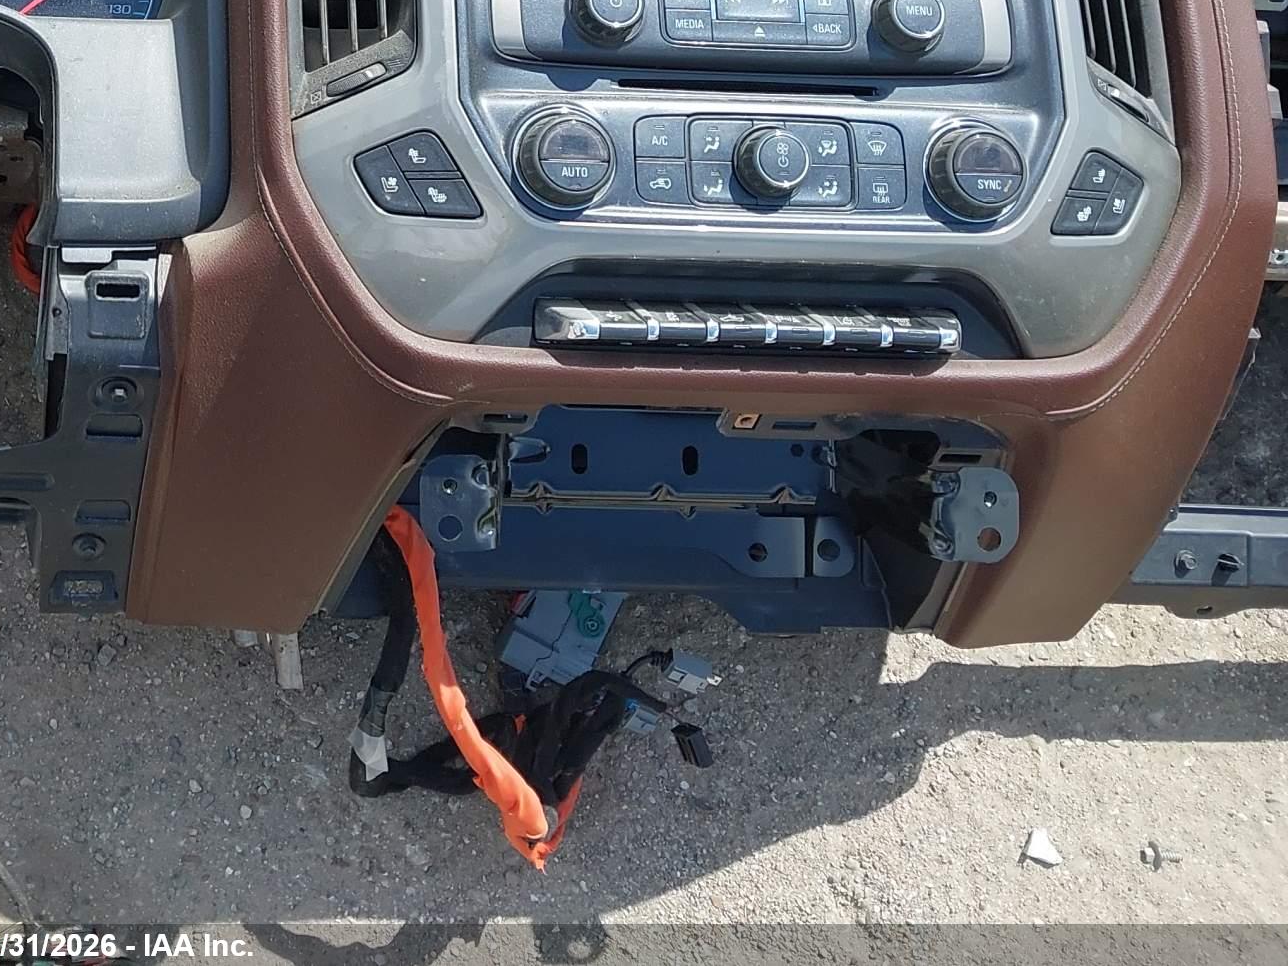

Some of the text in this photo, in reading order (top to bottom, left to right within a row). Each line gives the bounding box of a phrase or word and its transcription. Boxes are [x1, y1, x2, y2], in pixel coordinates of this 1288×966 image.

[109, 5, 132, 15] 130
[906, 5, 932, 16] MENU
[675, 18, 704, 29] MEDIA
[818, 23, 842, 33] BACK
[651, 136, 668, 146] A/C
[562, 167, 588, 177] AUTO
[977, 179, 1002, 190] SYNC
[873, 196, 890, 204] REAR
